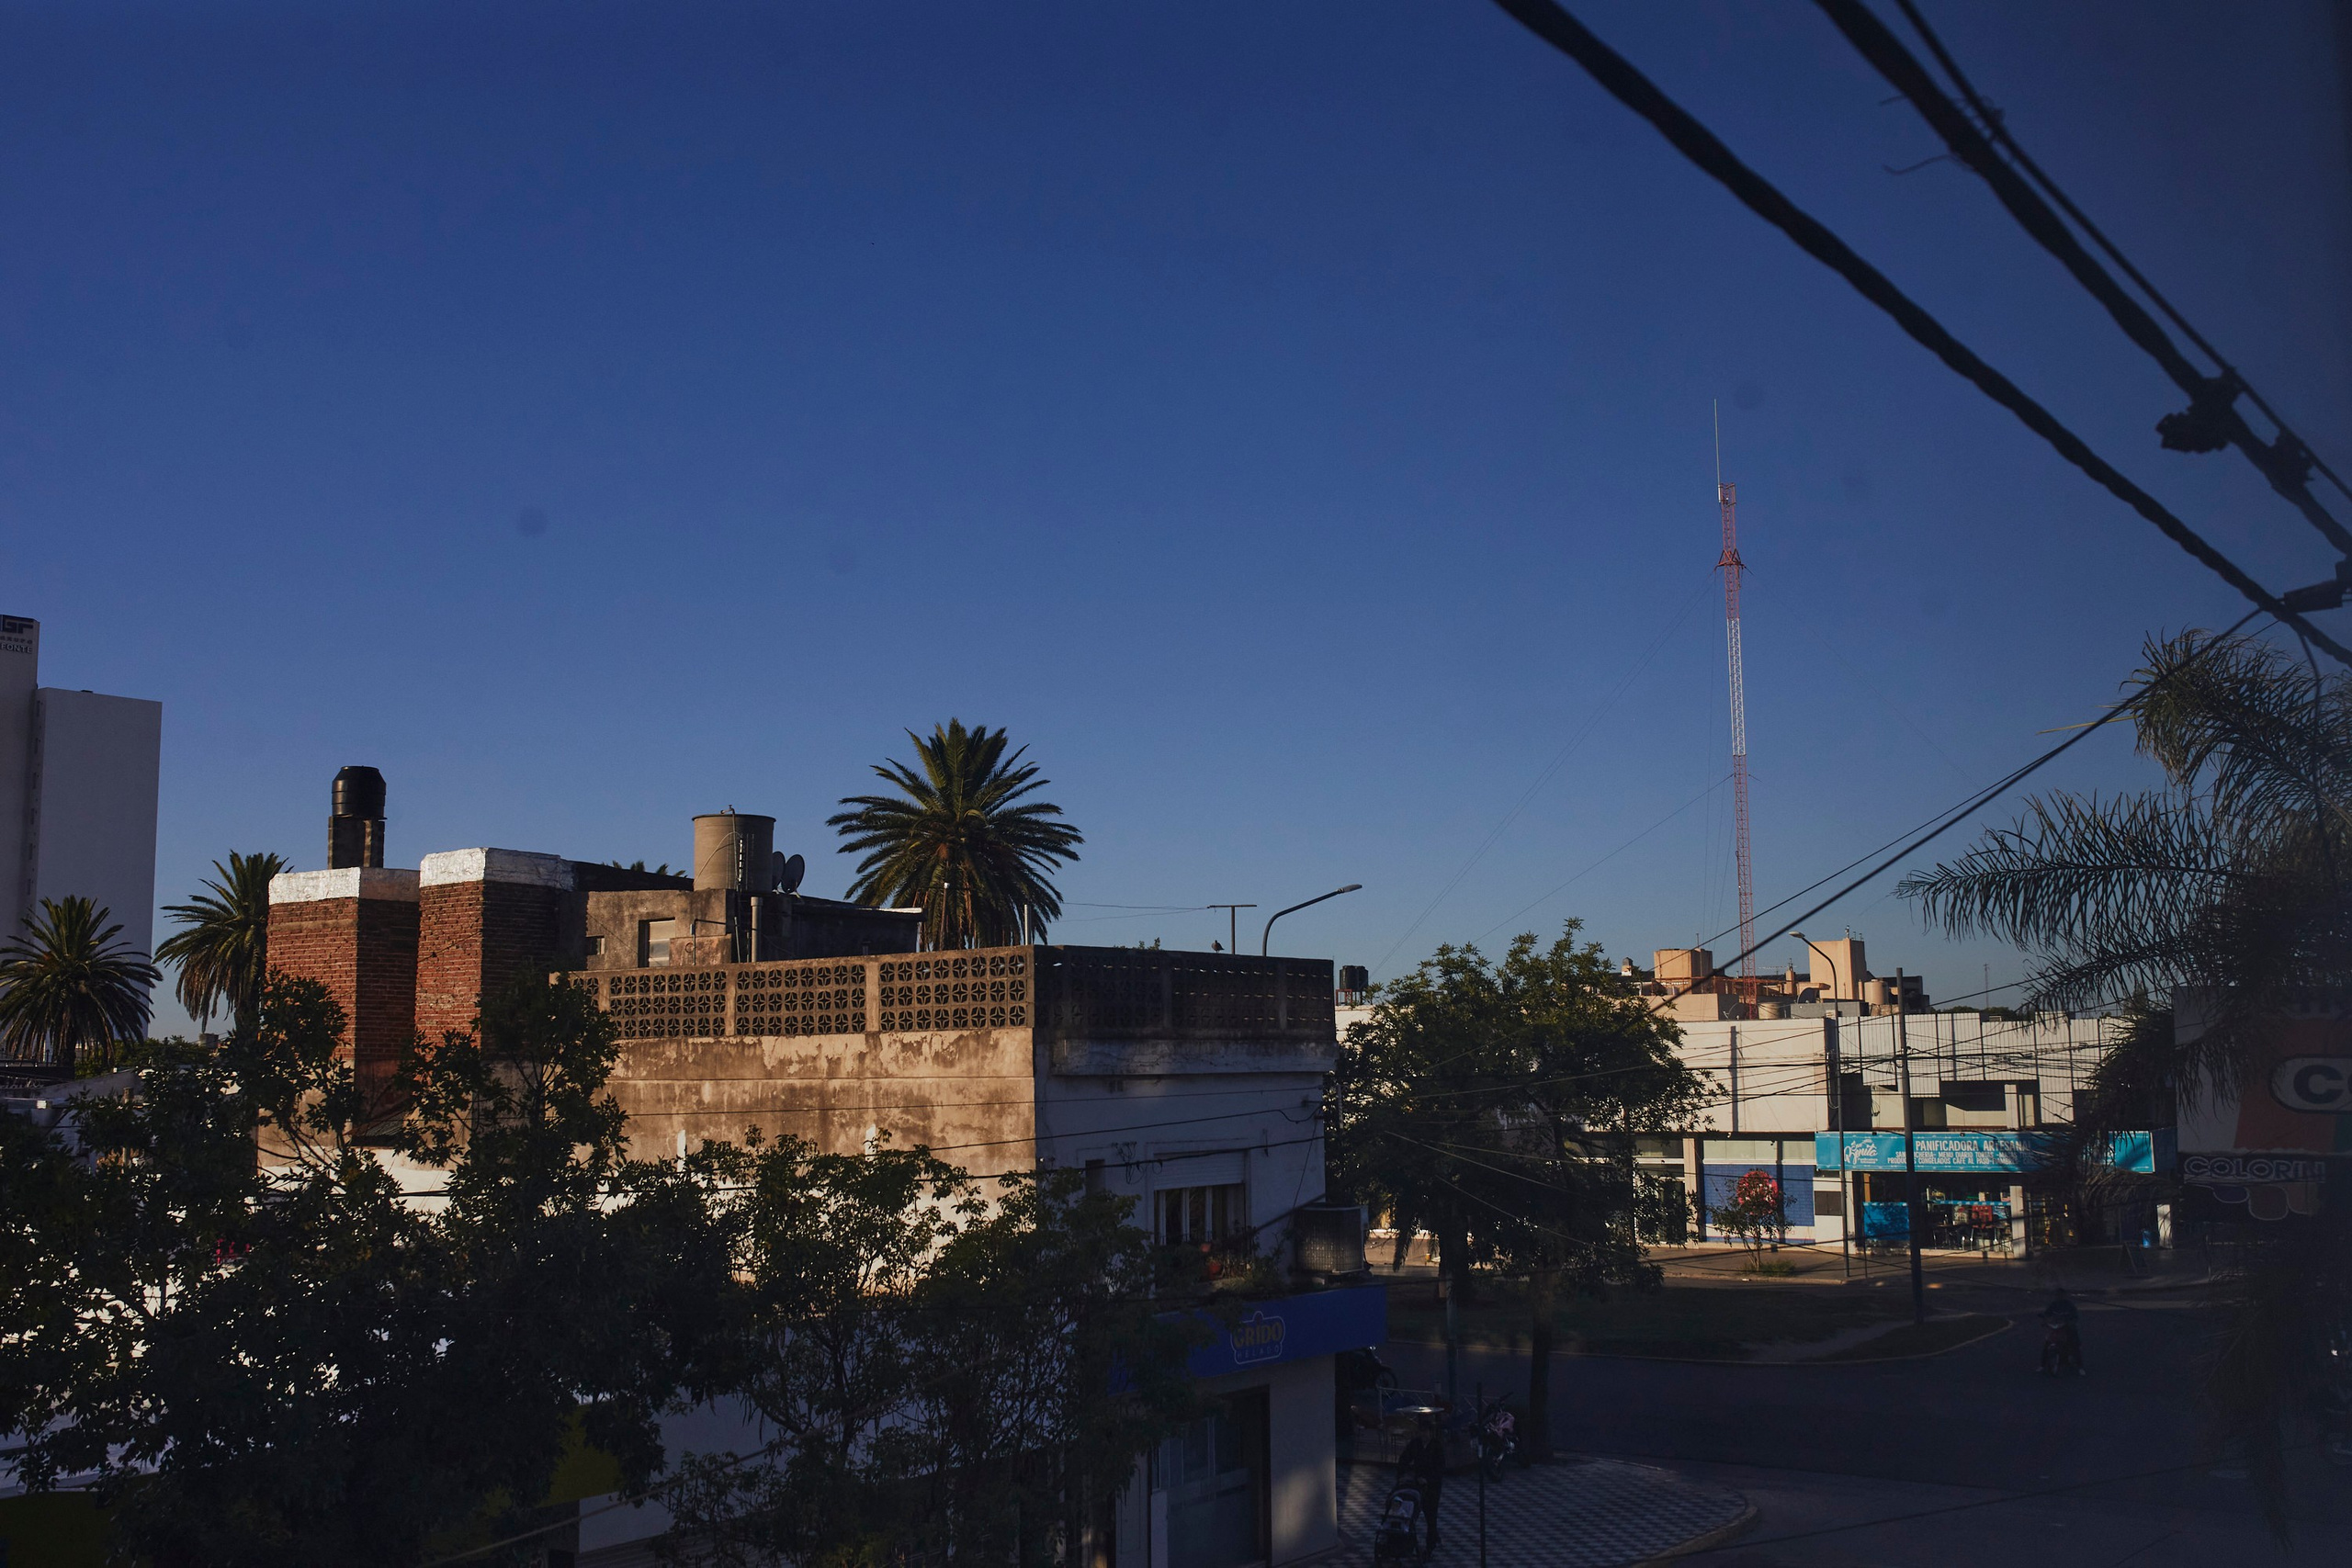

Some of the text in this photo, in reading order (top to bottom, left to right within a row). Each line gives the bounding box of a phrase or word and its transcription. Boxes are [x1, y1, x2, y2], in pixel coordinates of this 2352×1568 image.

[2293, 1064, 2352, 1105] C
[1915, 1140, 2031, 1152] PANIFICADORA ARTESANAL
[1233, 1320, 1283, 1349] GRIDO
